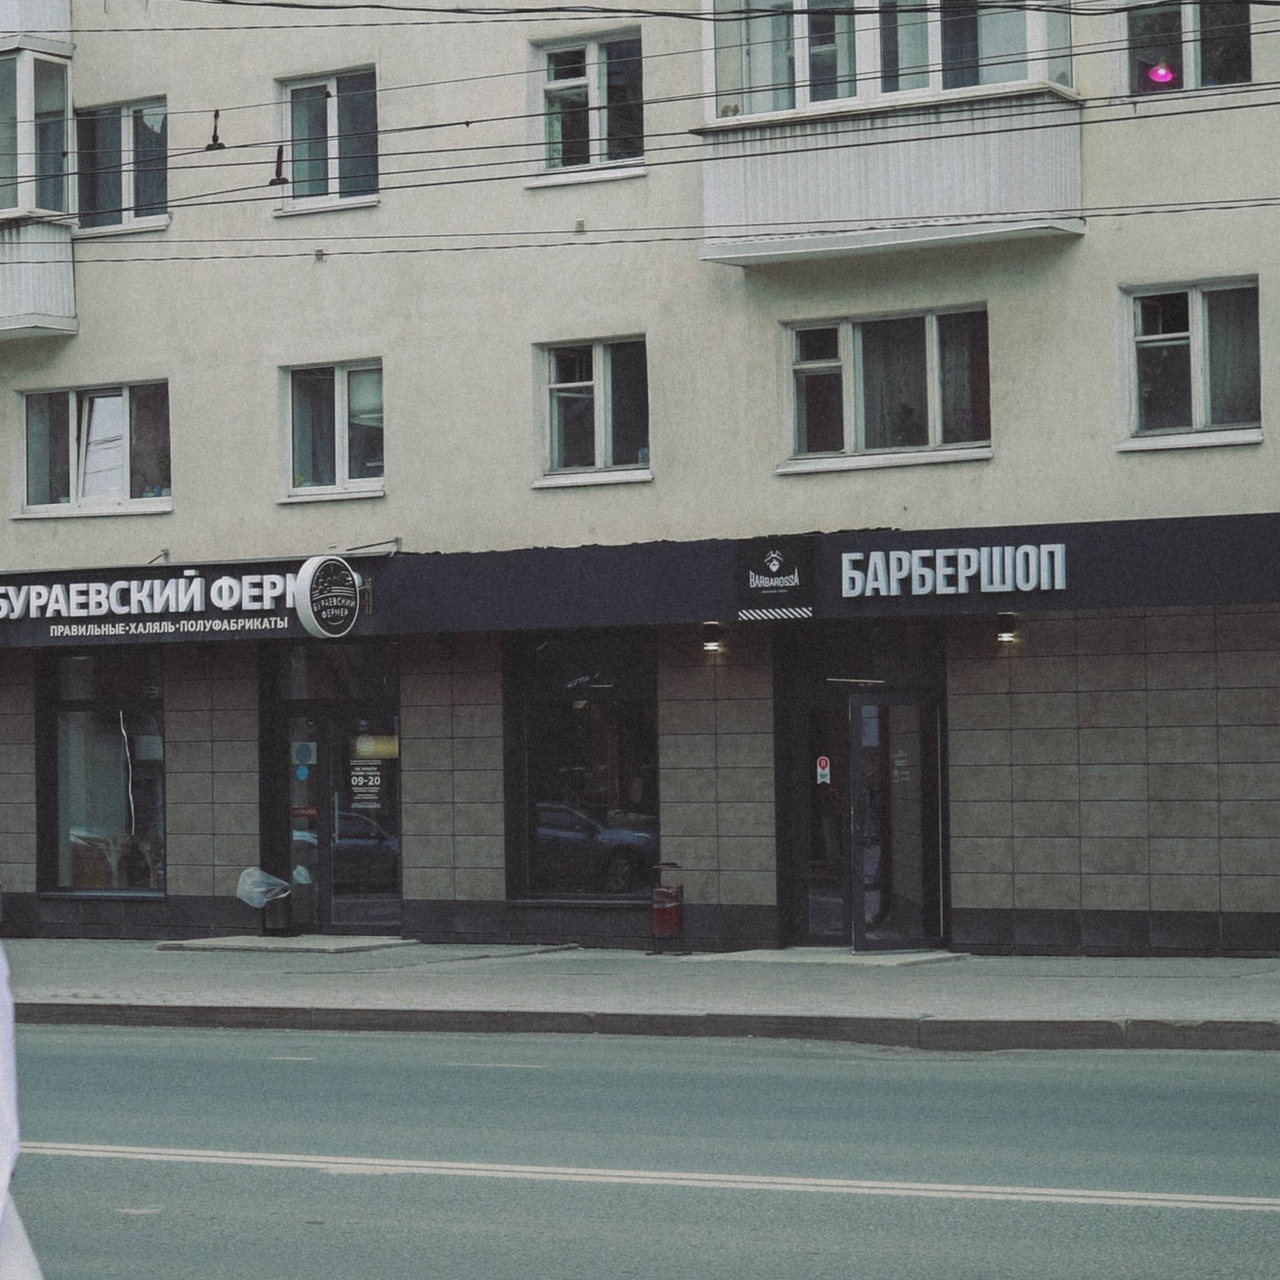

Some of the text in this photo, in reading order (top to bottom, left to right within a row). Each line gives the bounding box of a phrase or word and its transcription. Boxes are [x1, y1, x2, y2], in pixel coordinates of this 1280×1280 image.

[749, 566, 800, 589] BARBAROSSA
[841, 543, 1067, 598] БАРБЕРШОП
[351, 776, 381, 786] 09-20
